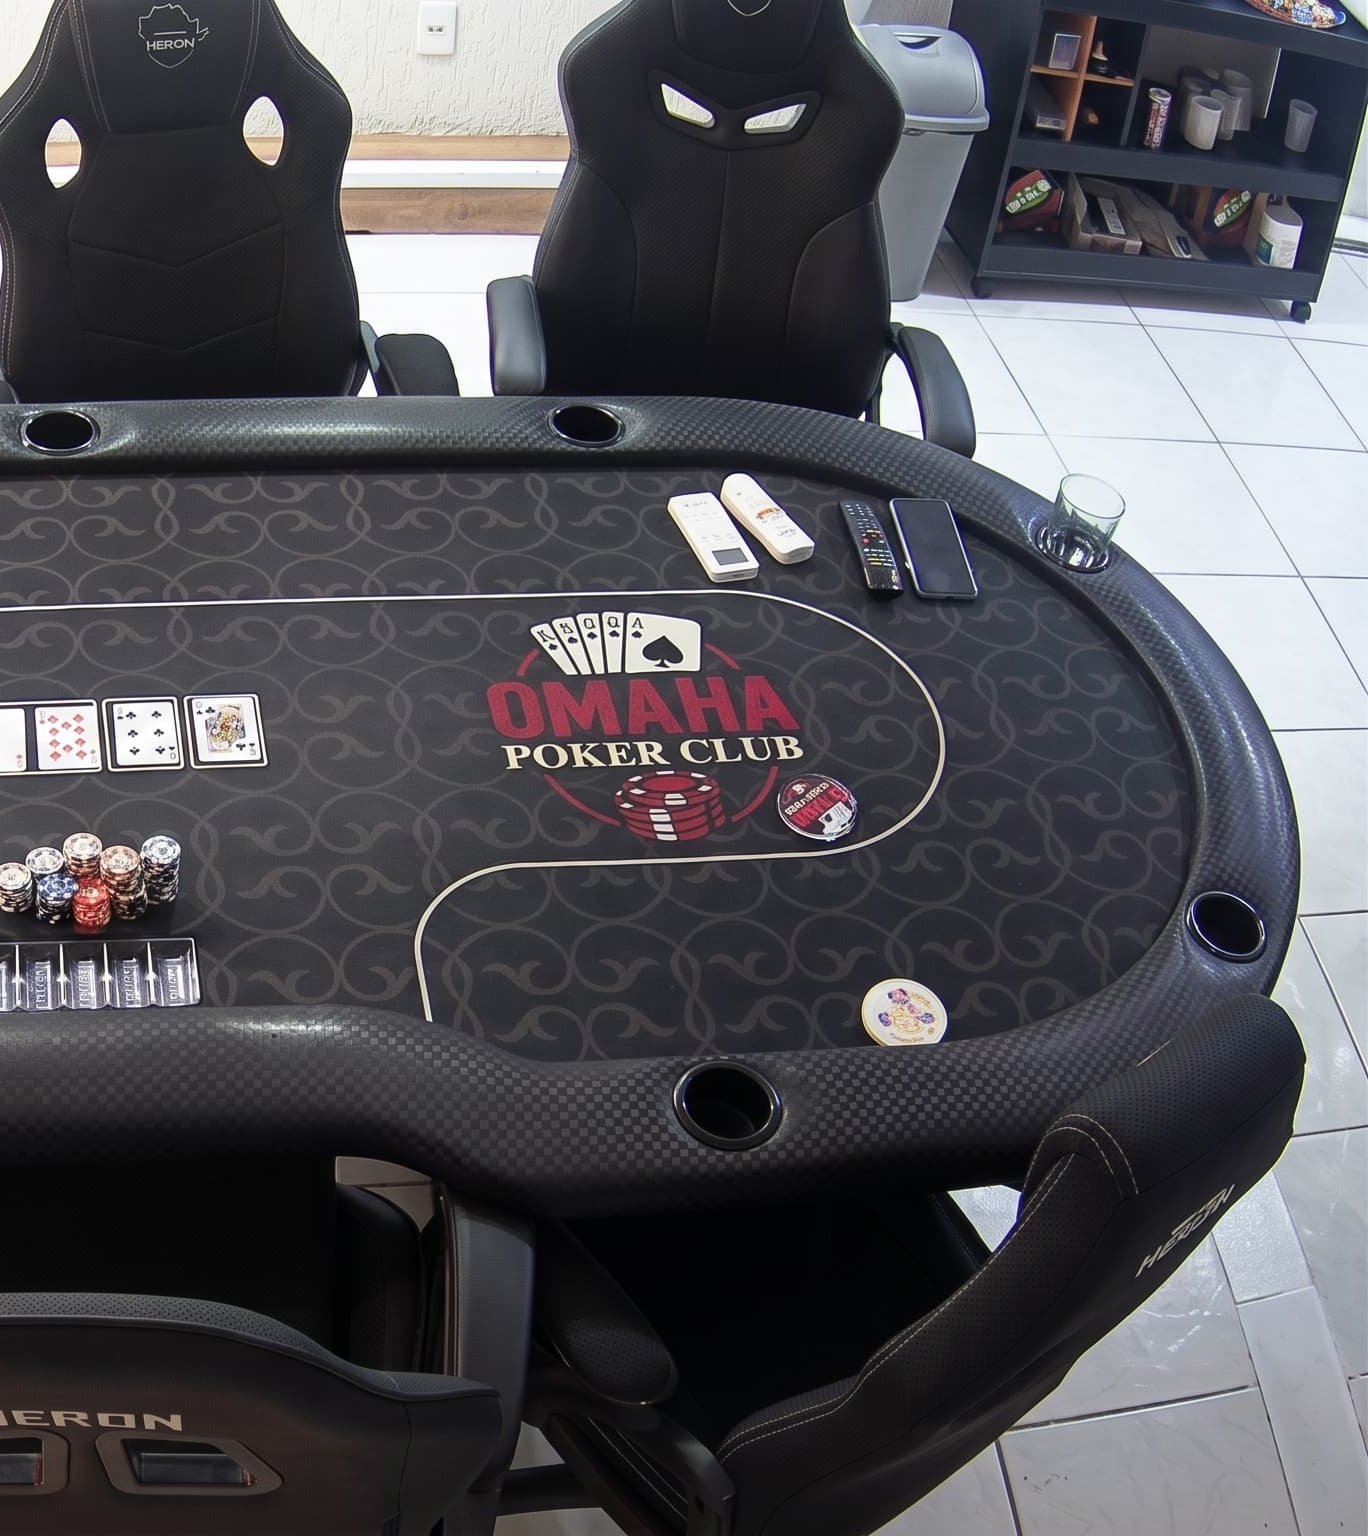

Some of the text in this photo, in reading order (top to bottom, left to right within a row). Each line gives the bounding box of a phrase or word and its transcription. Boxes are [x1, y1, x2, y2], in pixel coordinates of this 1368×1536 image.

[146, 37, 195, 52] HERON
[631, 617, 644, 629] A
[486, 675, 800, 740] OMAHA
[501, 735, 805, 770] POKER CLUB
